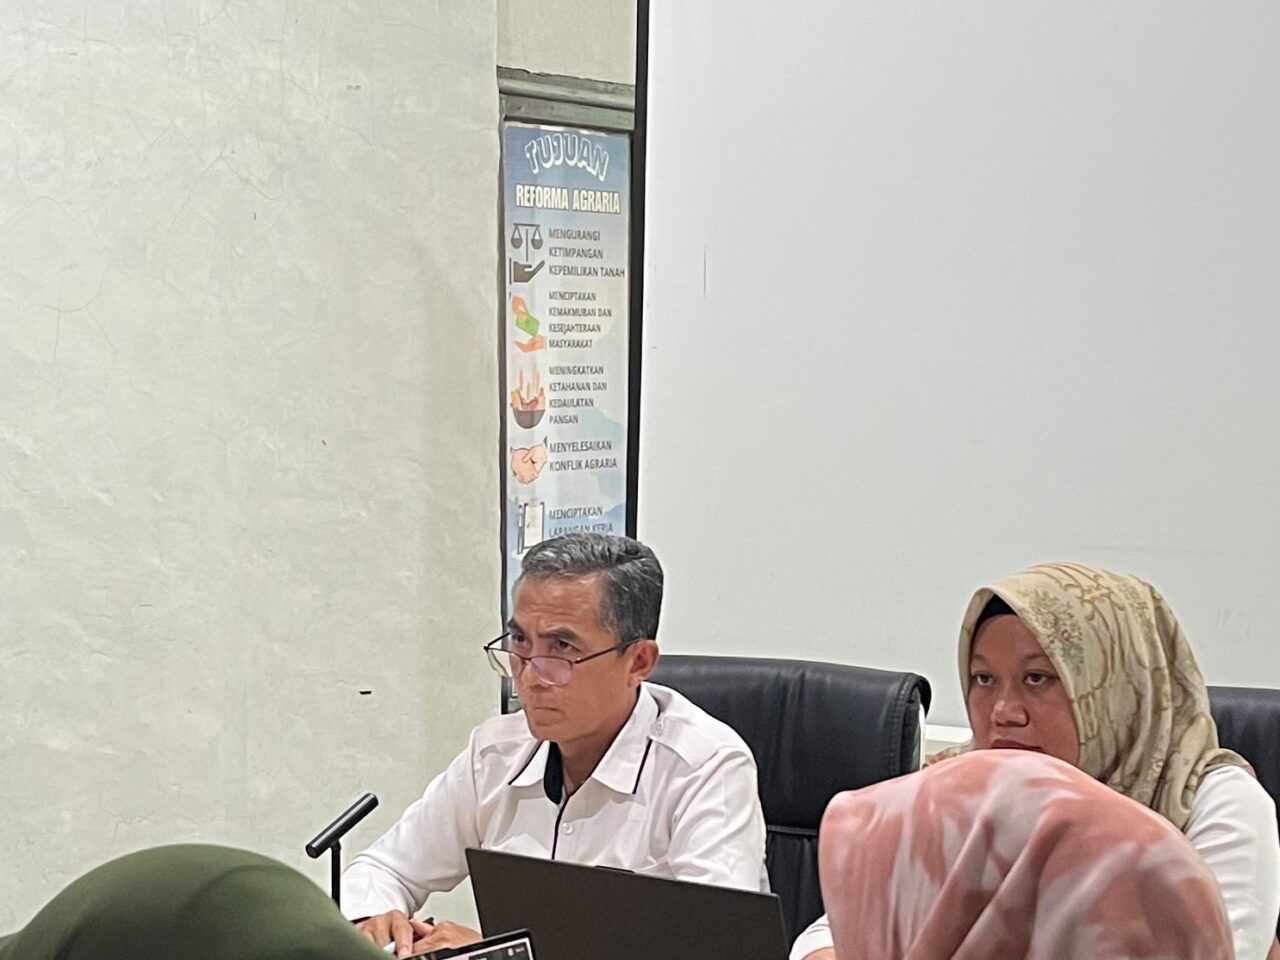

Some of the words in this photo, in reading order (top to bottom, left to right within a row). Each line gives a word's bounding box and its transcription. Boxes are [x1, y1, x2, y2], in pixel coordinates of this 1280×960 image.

[524, 133, 609, 182] TUJUAN
[516, 184, 569, 210] REFORMA
[572, 188, 621, 214] AGRARIA
[549, 228, 601, 241] MENGURANGI
[549, 247, 604, 260] KETIMPANGAN
[549, 265, 598, 277] KEPEMILIKAN
[600, 267, 625, 278] TANAH
[549, 291, 597, 301] MENCIPTAKAN
[549, 307, 596, 317] KEMAKMURAN
[598, 307, 612, 317] DAN
[549, 323, 601, 334] KESEJAHTERAAN
[549, 339, 593, 348] MASYARAKAT
[549, 365, 604, 376] MENINGKATKAN
[549, 382, 591, 392] KETAHANAN
[592, 381, 608, 391] DAN
[549, 398, 595, 408] KEDAULATAN
[549, 414, 579, 424] PANGAN
[549, 440, 613, 453] MENYELESAIKAN
[549, 460, 582, 472] KONFLIK
[584, 457, 618, 470] AGRARIA
[549, 506, 604, 520] MENCIPTAKAN
